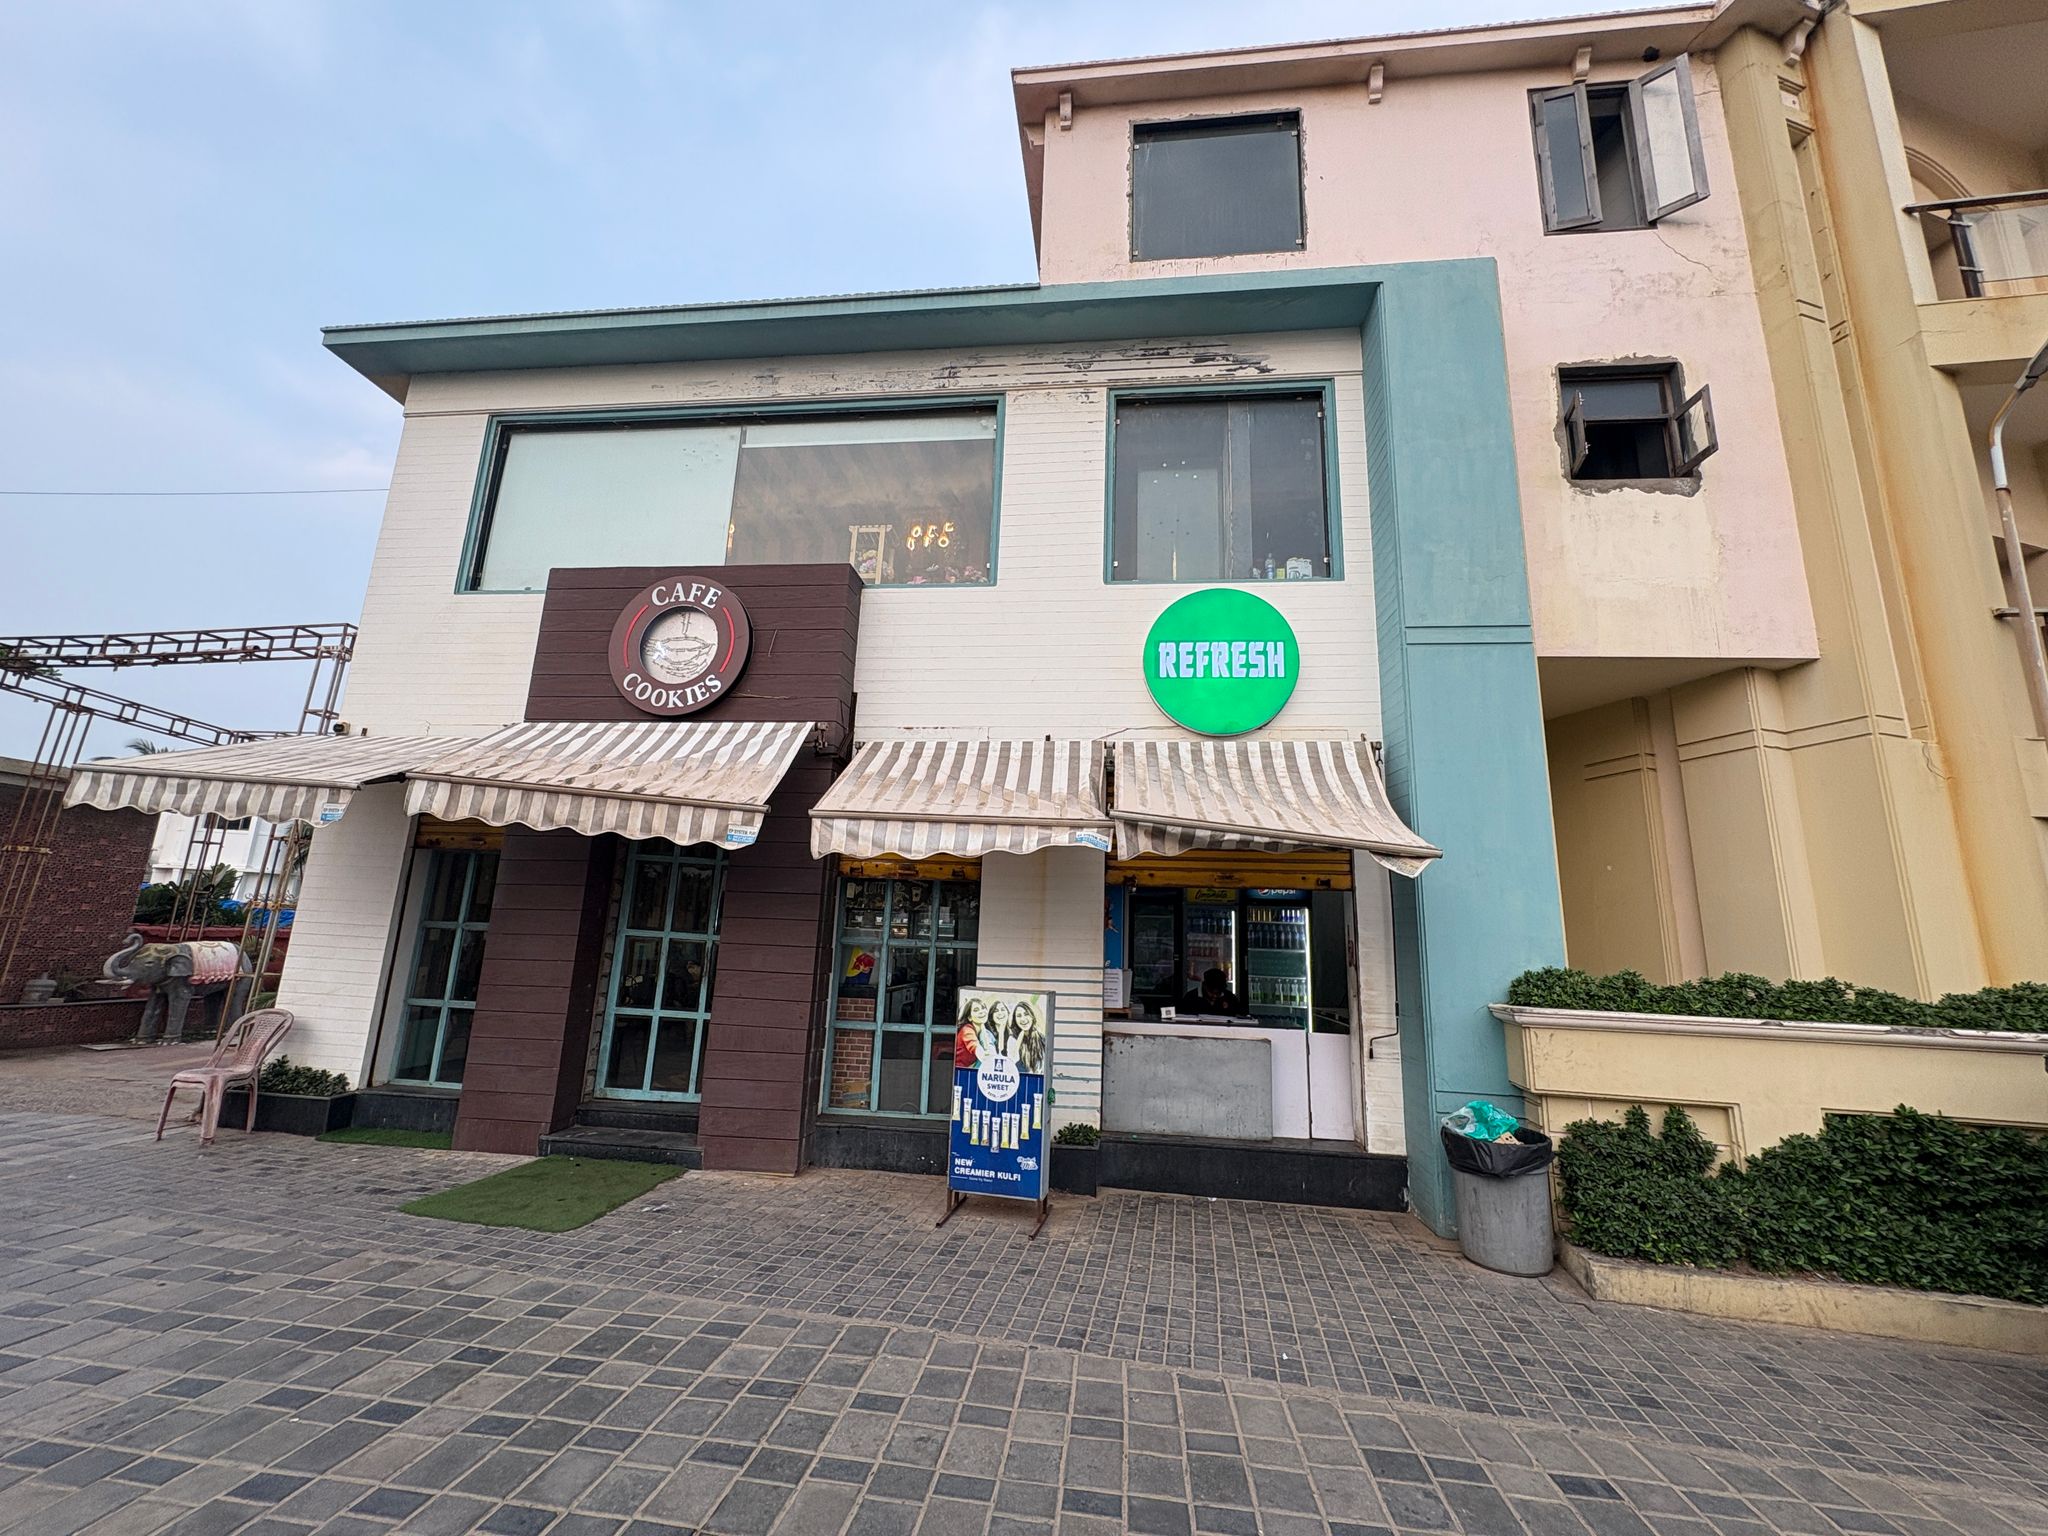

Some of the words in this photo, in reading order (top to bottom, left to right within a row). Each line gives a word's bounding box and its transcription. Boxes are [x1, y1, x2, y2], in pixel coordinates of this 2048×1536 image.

[652, 583, 722, 609] CAFE
[1158, 641, 1285, 678] REFRESH
[623, 673, 722, 708] COOKIES
[982, 1073, 1015, 1083] NARULA
[955, 1158, 973, 1167] NEW
[954, 1167, 995, 1178] CREAMIER
[998, 1172, 1021, 1181] KULFI
